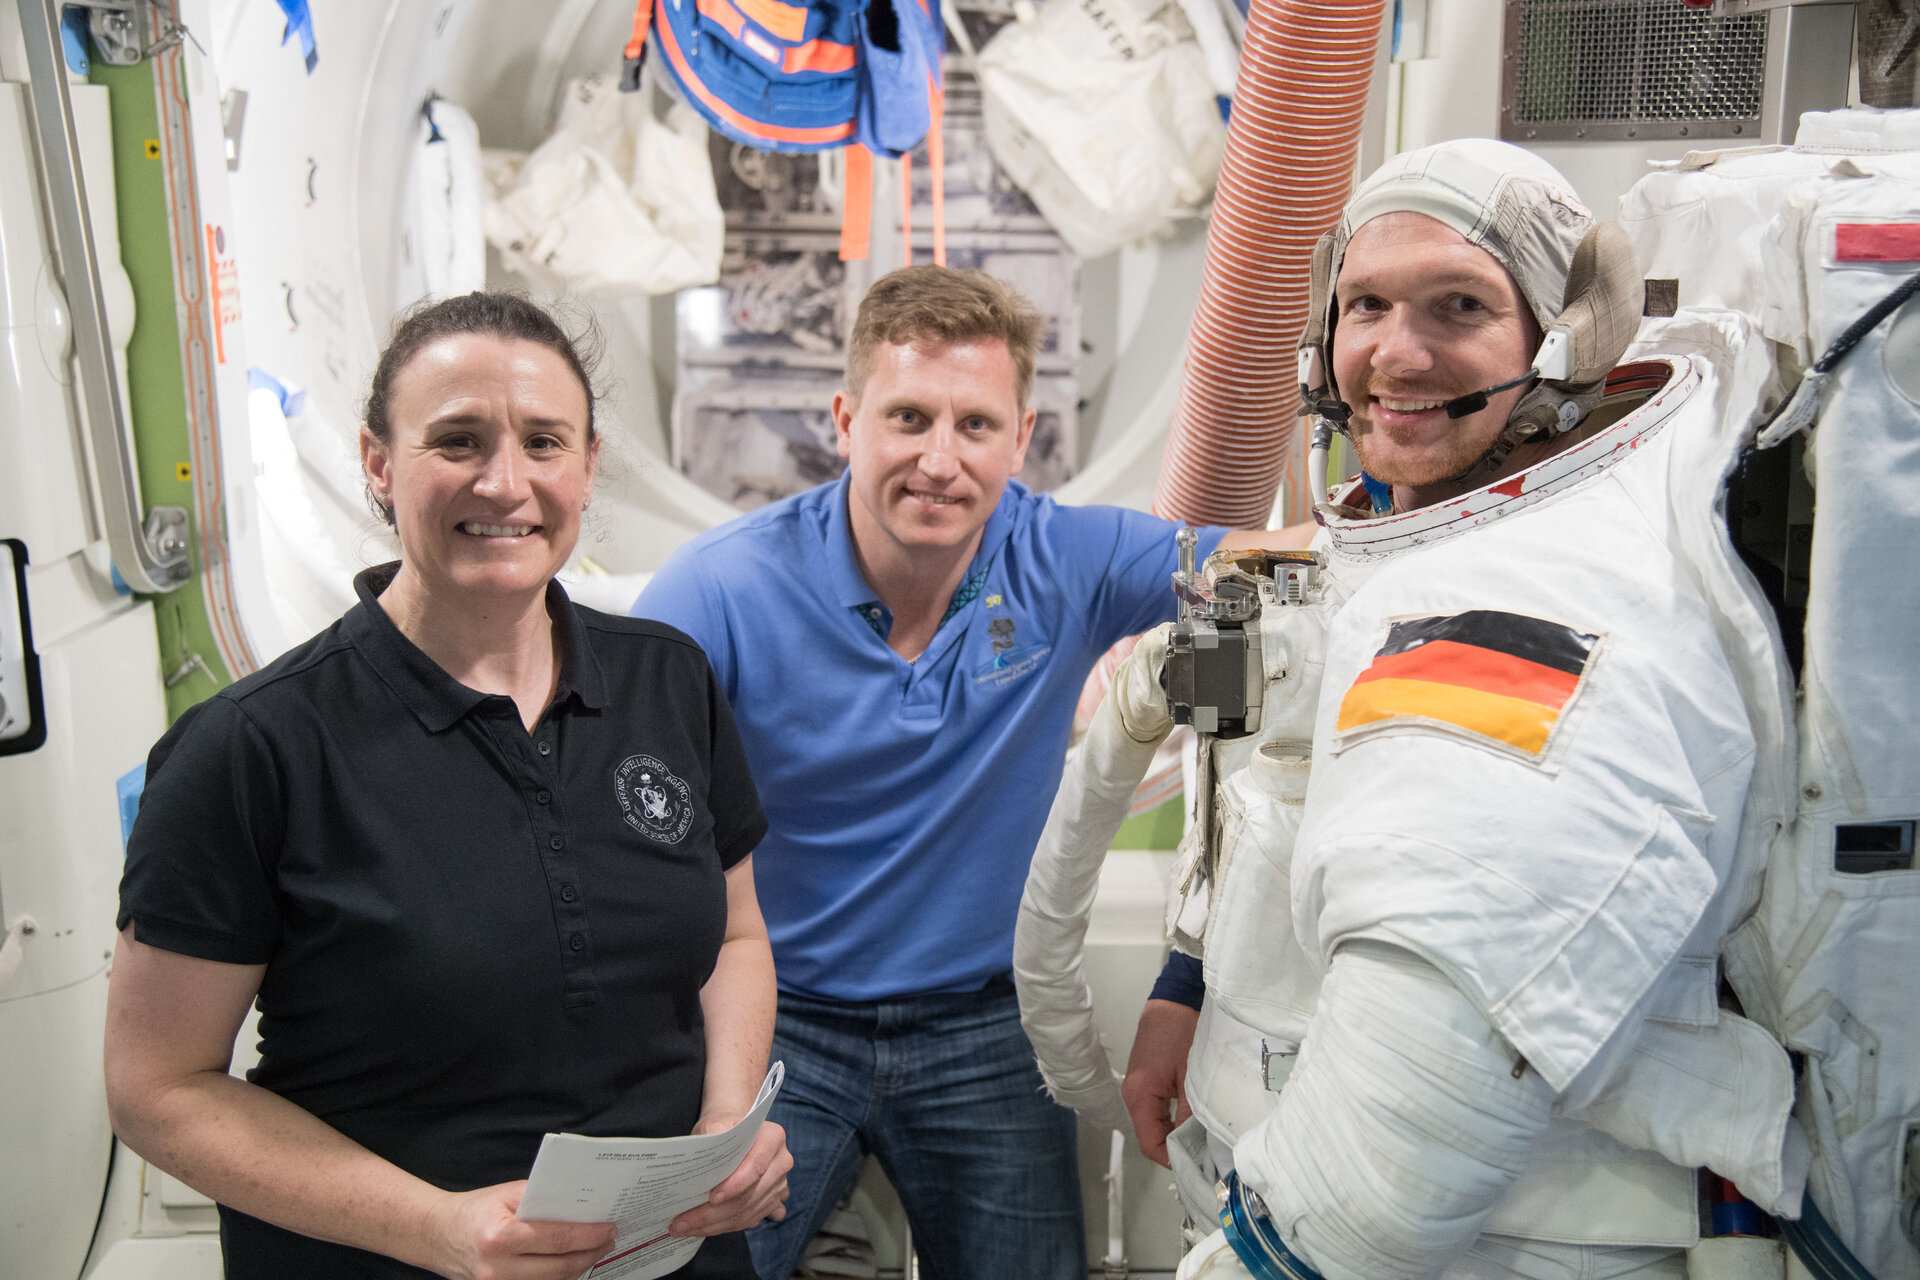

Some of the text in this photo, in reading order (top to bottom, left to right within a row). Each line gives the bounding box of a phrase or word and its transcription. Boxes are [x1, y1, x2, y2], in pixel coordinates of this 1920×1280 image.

[617, 758, 689, 811] DEFENSE INTELLIGENCE AGENCY
[626, 813, 649, 834] UNITED
